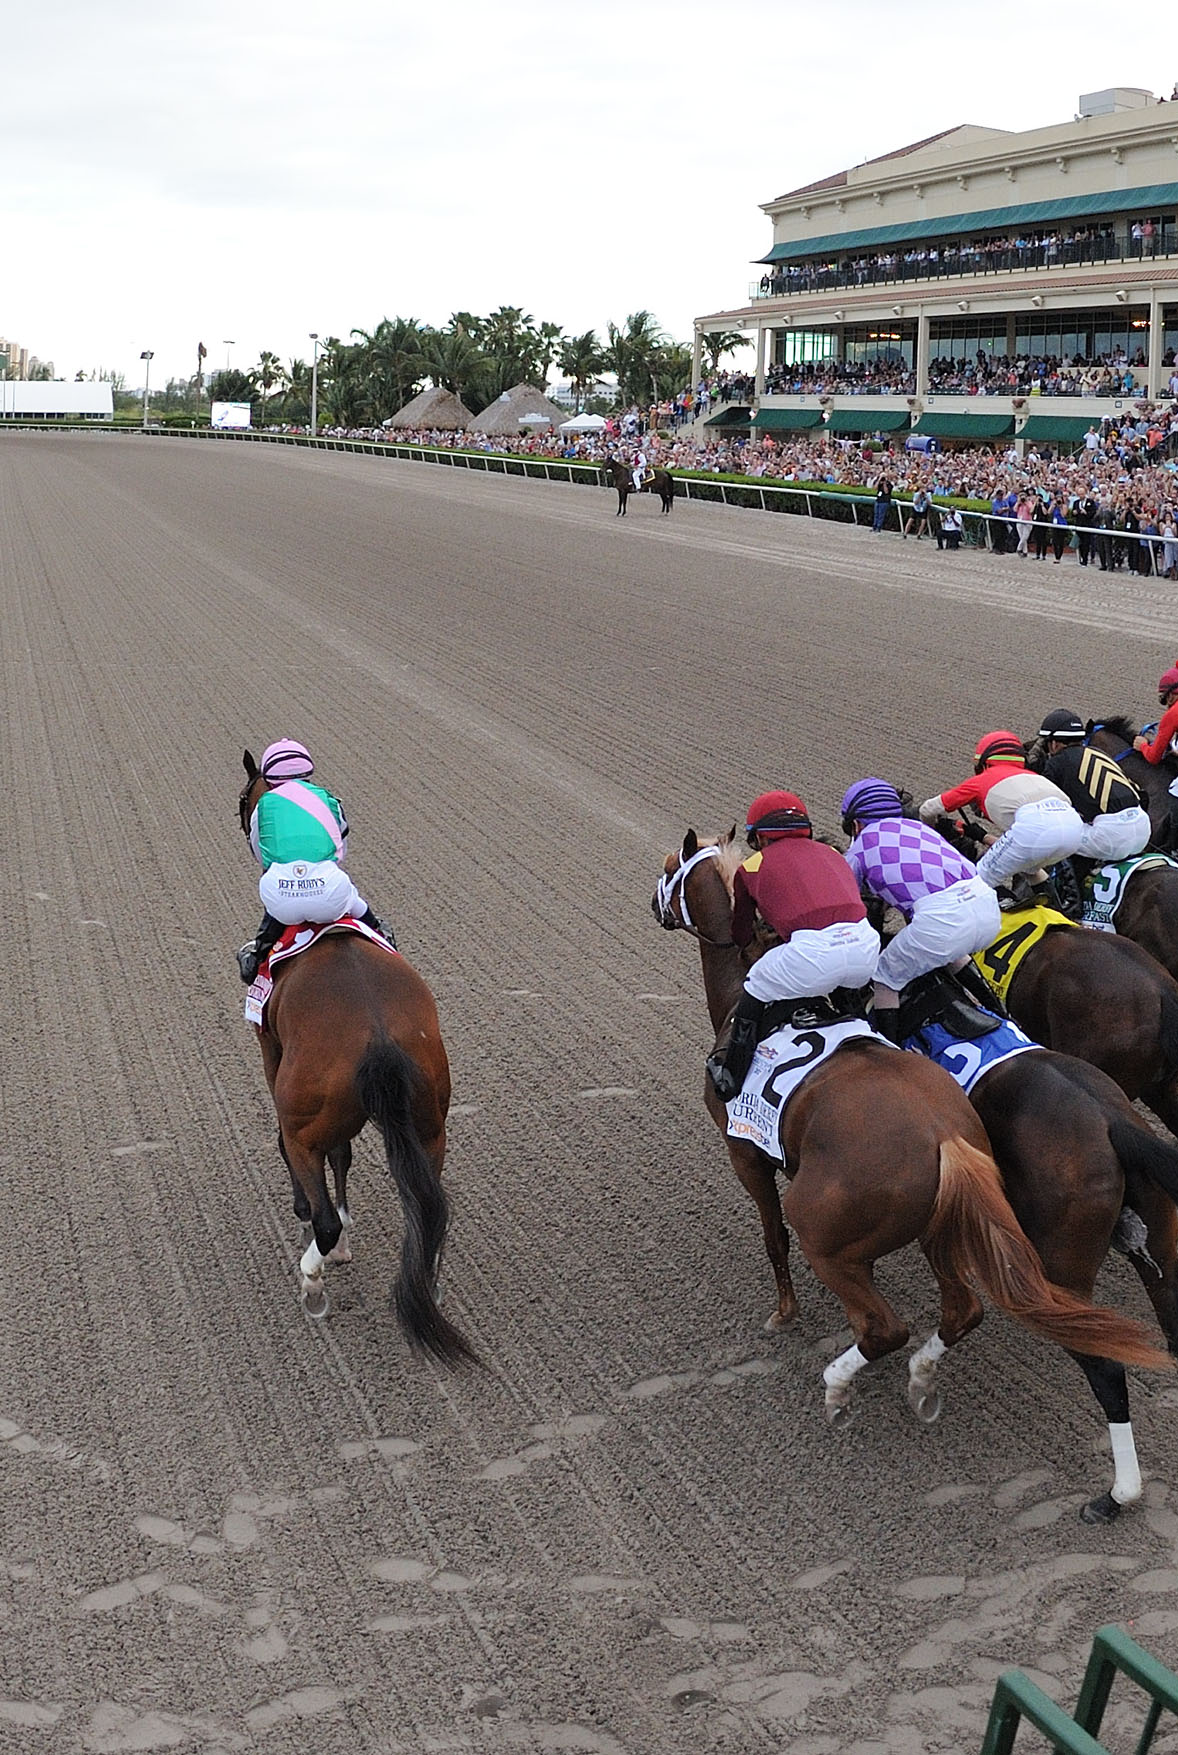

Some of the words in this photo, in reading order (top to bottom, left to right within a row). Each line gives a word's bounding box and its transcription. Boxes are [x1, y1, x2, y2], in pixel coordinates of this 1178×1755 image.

[278, 879, 295, 889] JEFF
[297, 877, 325, 890] RUBY'S
[983, 921, 1038, 982] 4
[761, 1030, 826, 1110] 2
